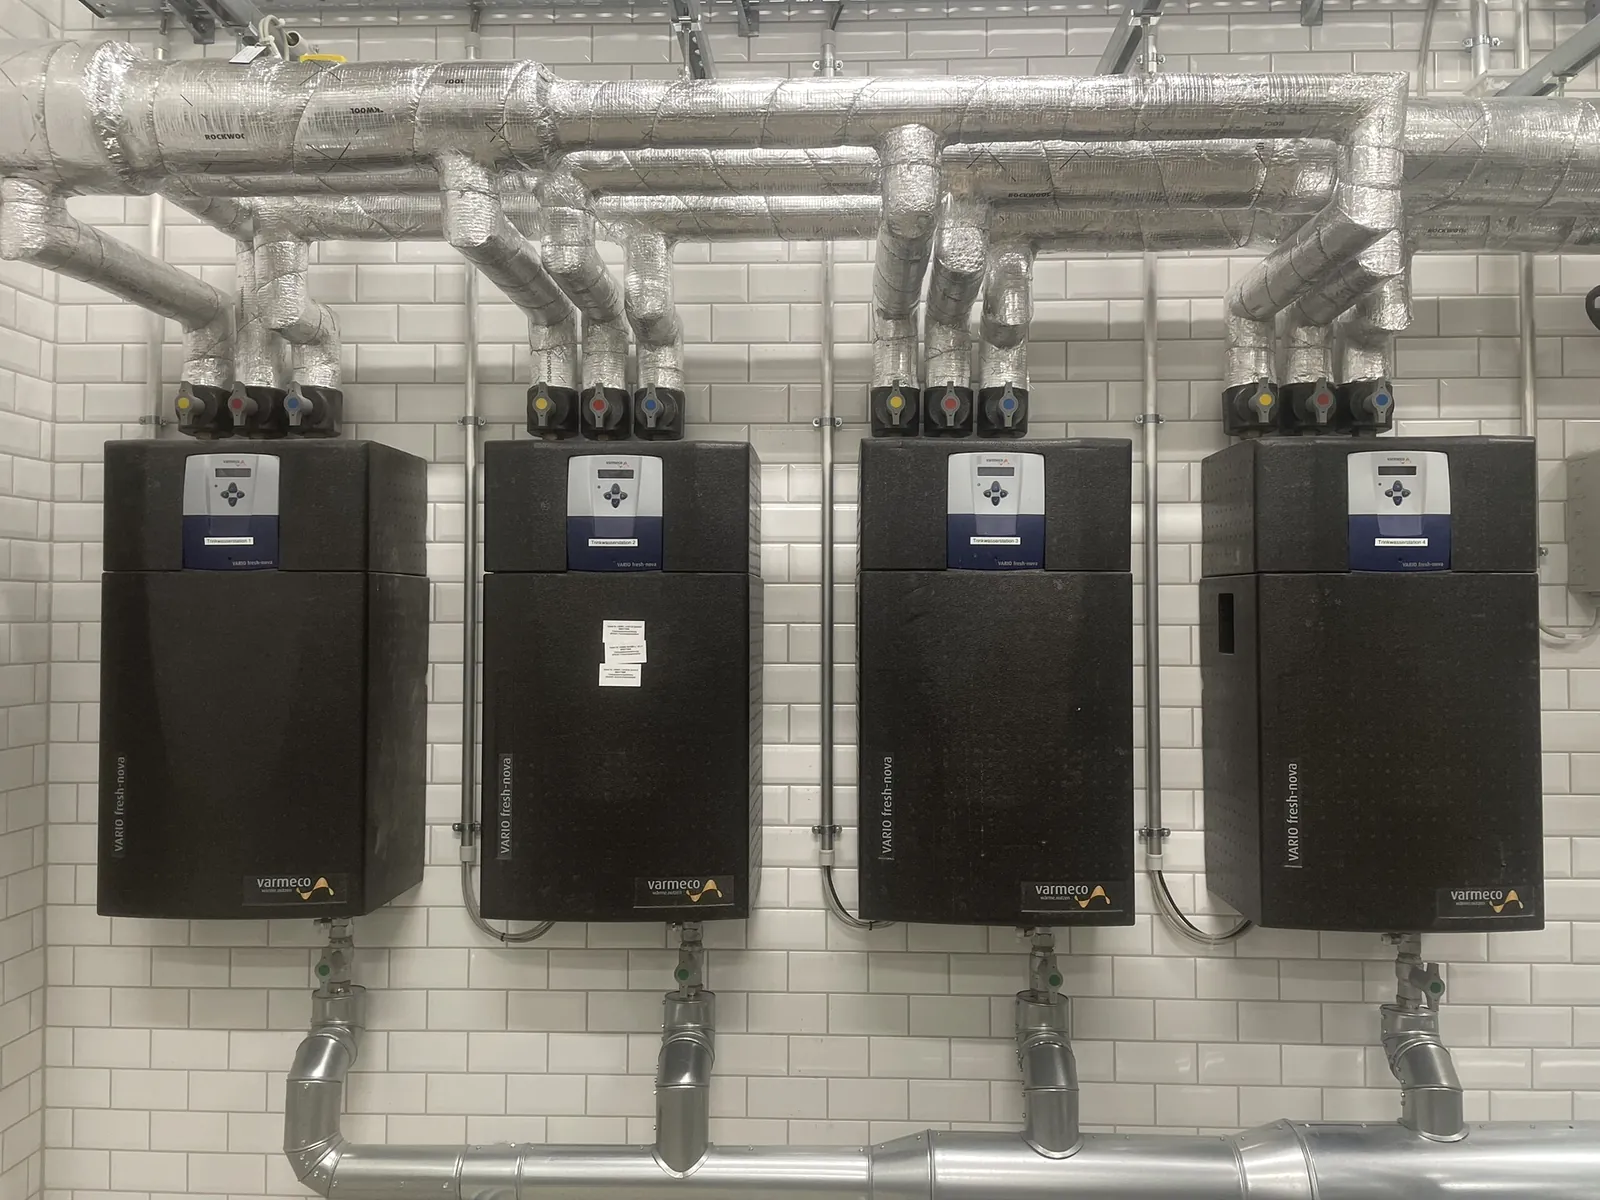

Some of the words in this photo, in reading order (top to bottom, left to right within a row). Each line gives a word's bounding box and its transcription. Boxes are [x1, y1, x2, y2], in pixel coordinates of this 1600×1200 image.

[114, 756, 125, 814] fresh-nova
[500, 758, 511, 816] fresh-nova
[881, 756, 892, 816] fresh-nova
[1286, 763, 1298, 823] fresh-nova
[114, 819, 124, 852] VARIO
[501, 820, 510, 853] VARIO
[882, 820, 892, 853] VARIO
[1288, 827, 1299, 861] VARIO
[257, 878, 311, 888] varmeco
[648, 880, 700, 889] varmeco
[1035, 885, 1088, 895] varmeco
[1451, 890, 1503, 900] varmeco
